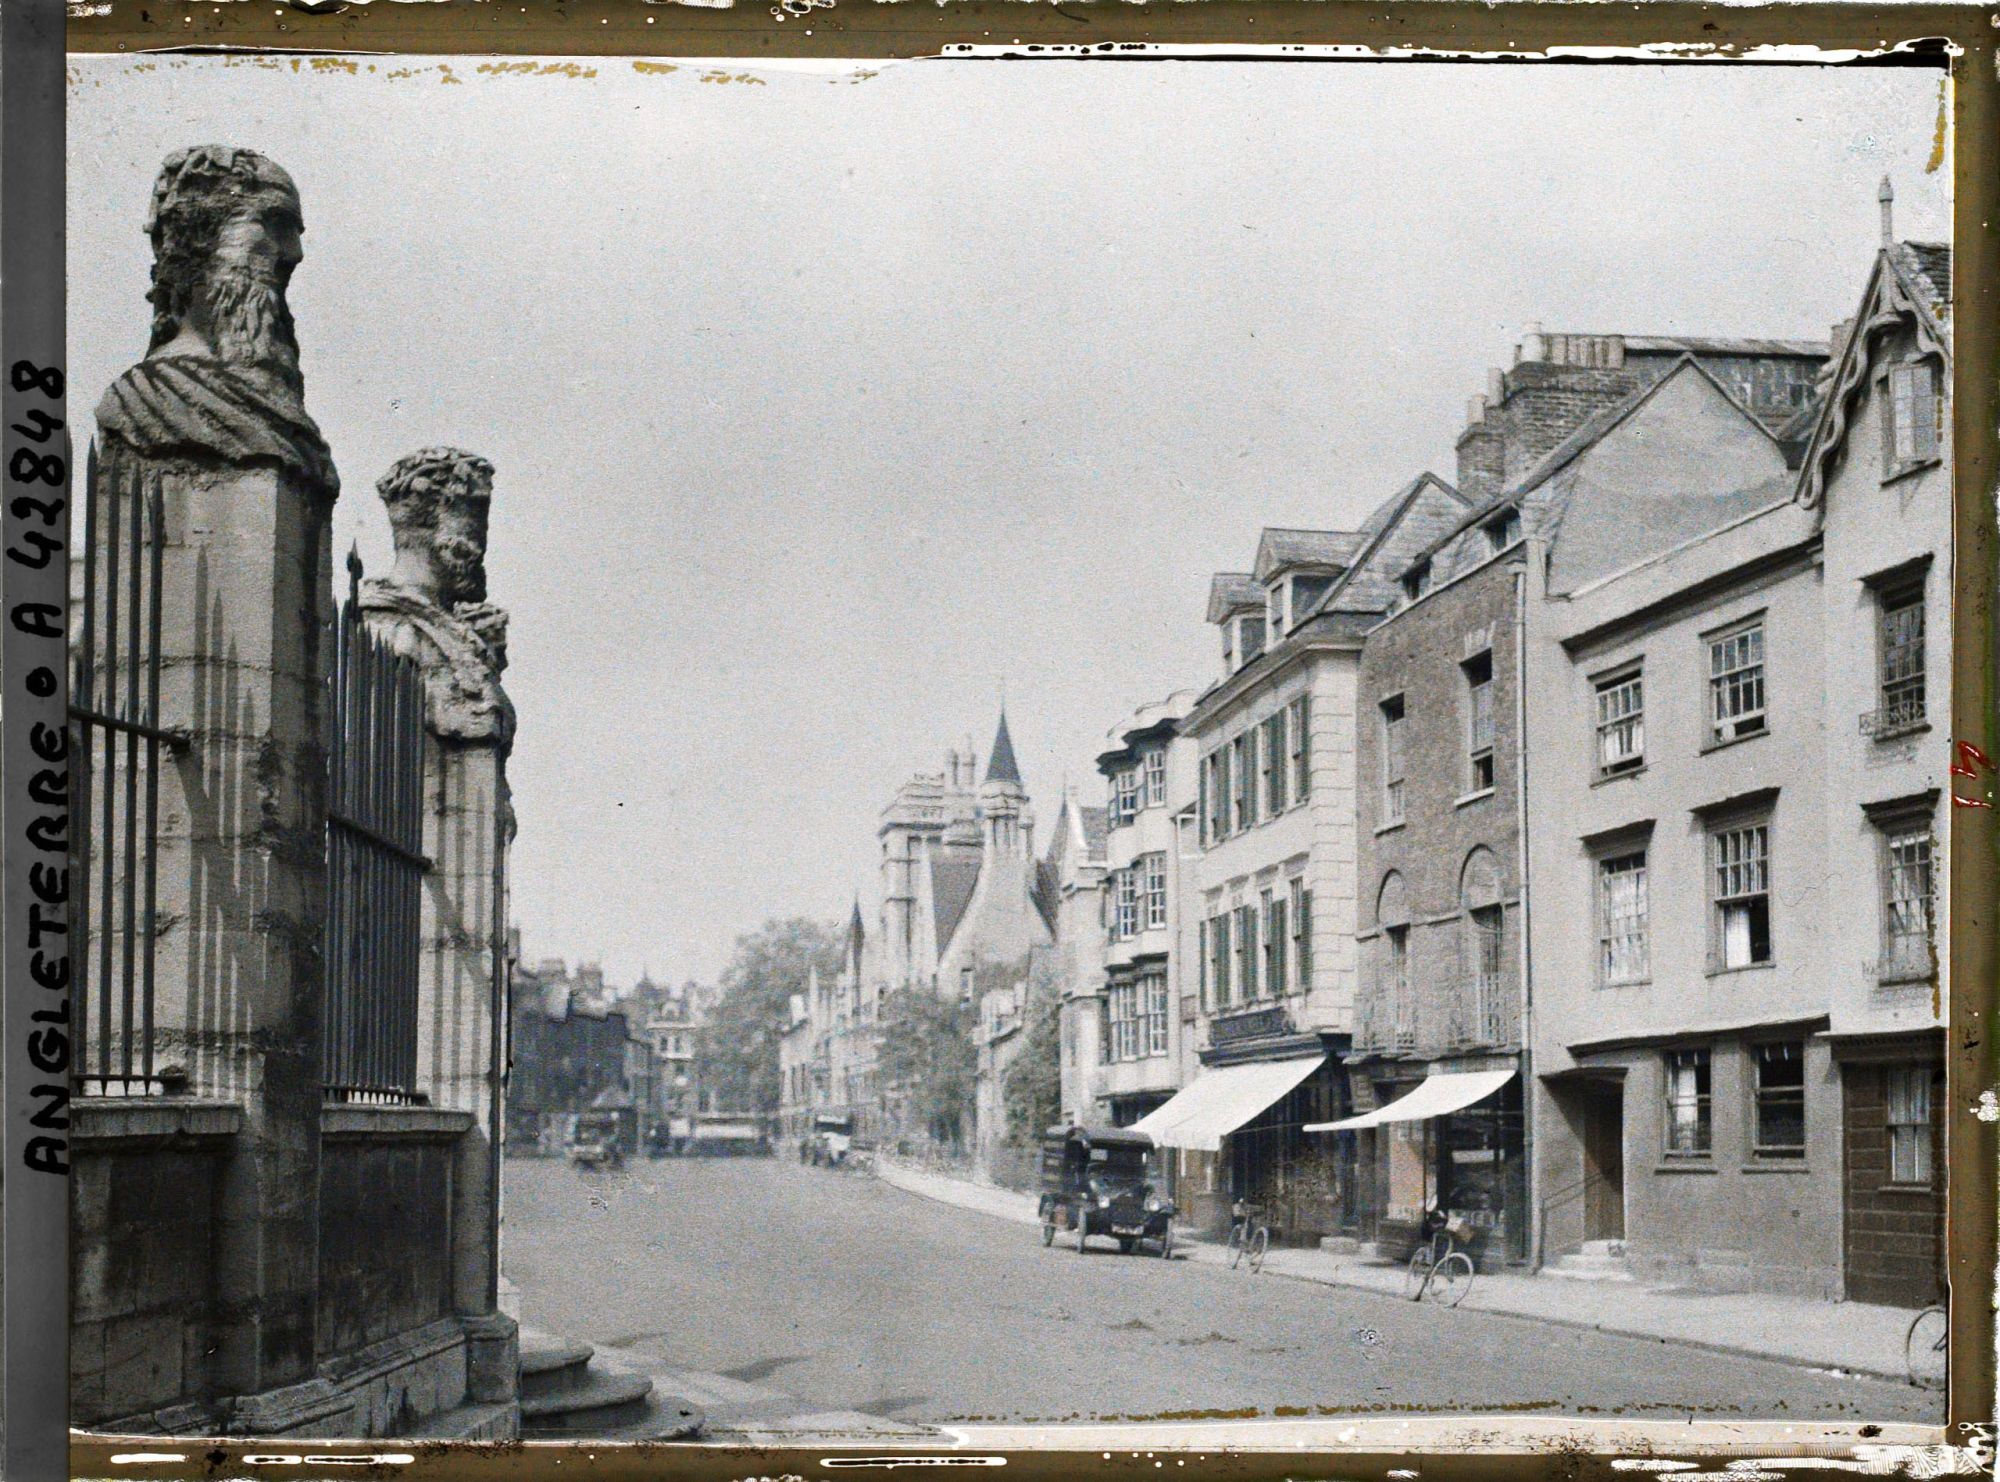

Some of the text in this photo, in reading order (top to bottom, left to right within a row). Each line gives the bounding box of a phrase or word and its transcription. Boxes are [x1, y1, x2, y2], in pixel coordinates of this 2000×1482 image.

[6, 359, 68, 1176] ANGLETERRE A 42848
